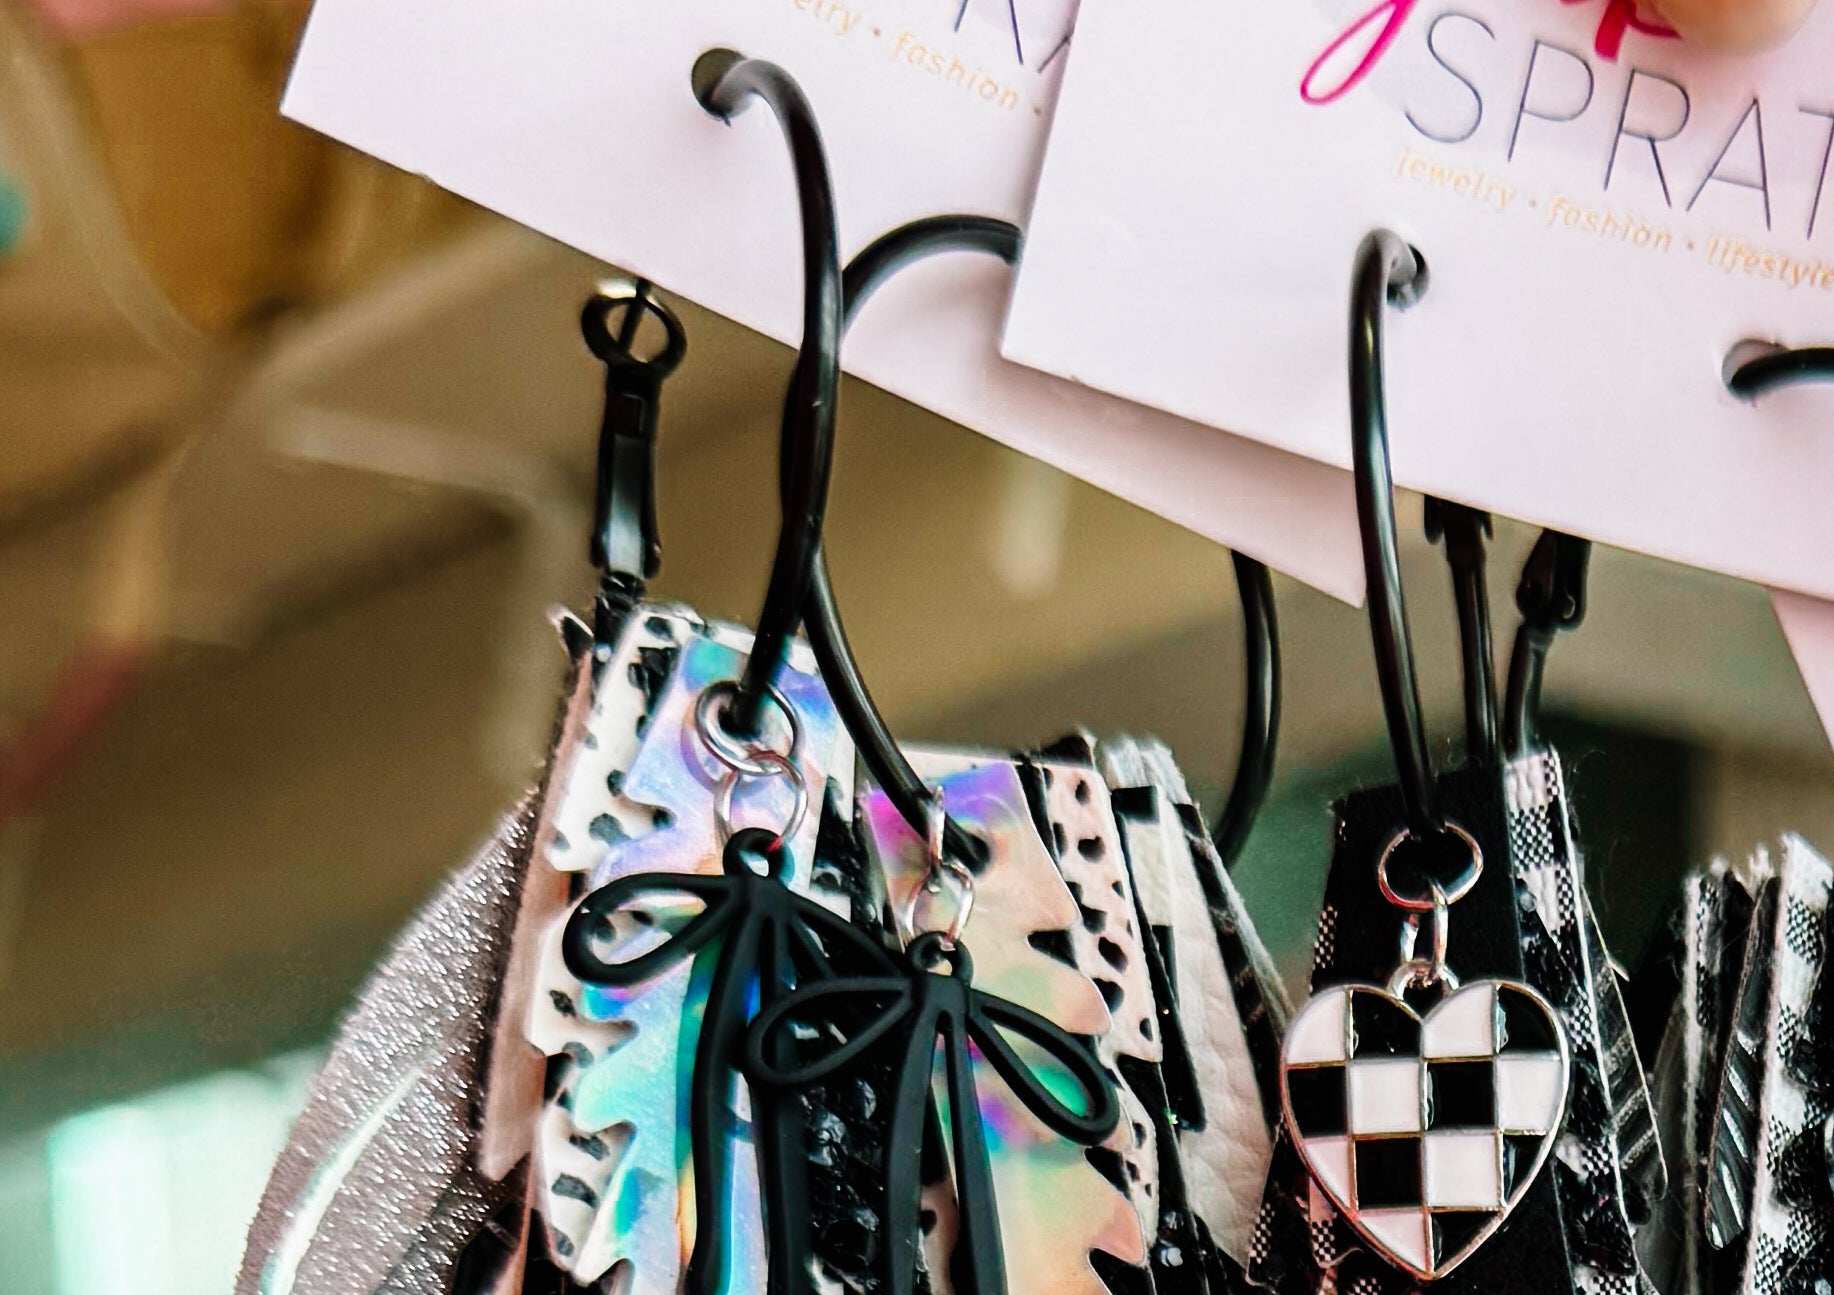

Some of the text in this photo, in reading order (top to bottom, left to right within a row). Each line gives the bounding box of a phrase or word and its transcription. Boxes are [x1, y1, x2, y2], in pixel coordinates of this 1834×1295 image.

[889, 29, 1019, 111] fashion
[1393, 149, 1515, 210] jewelry
[1545, 196, 1674, 253] fashion
